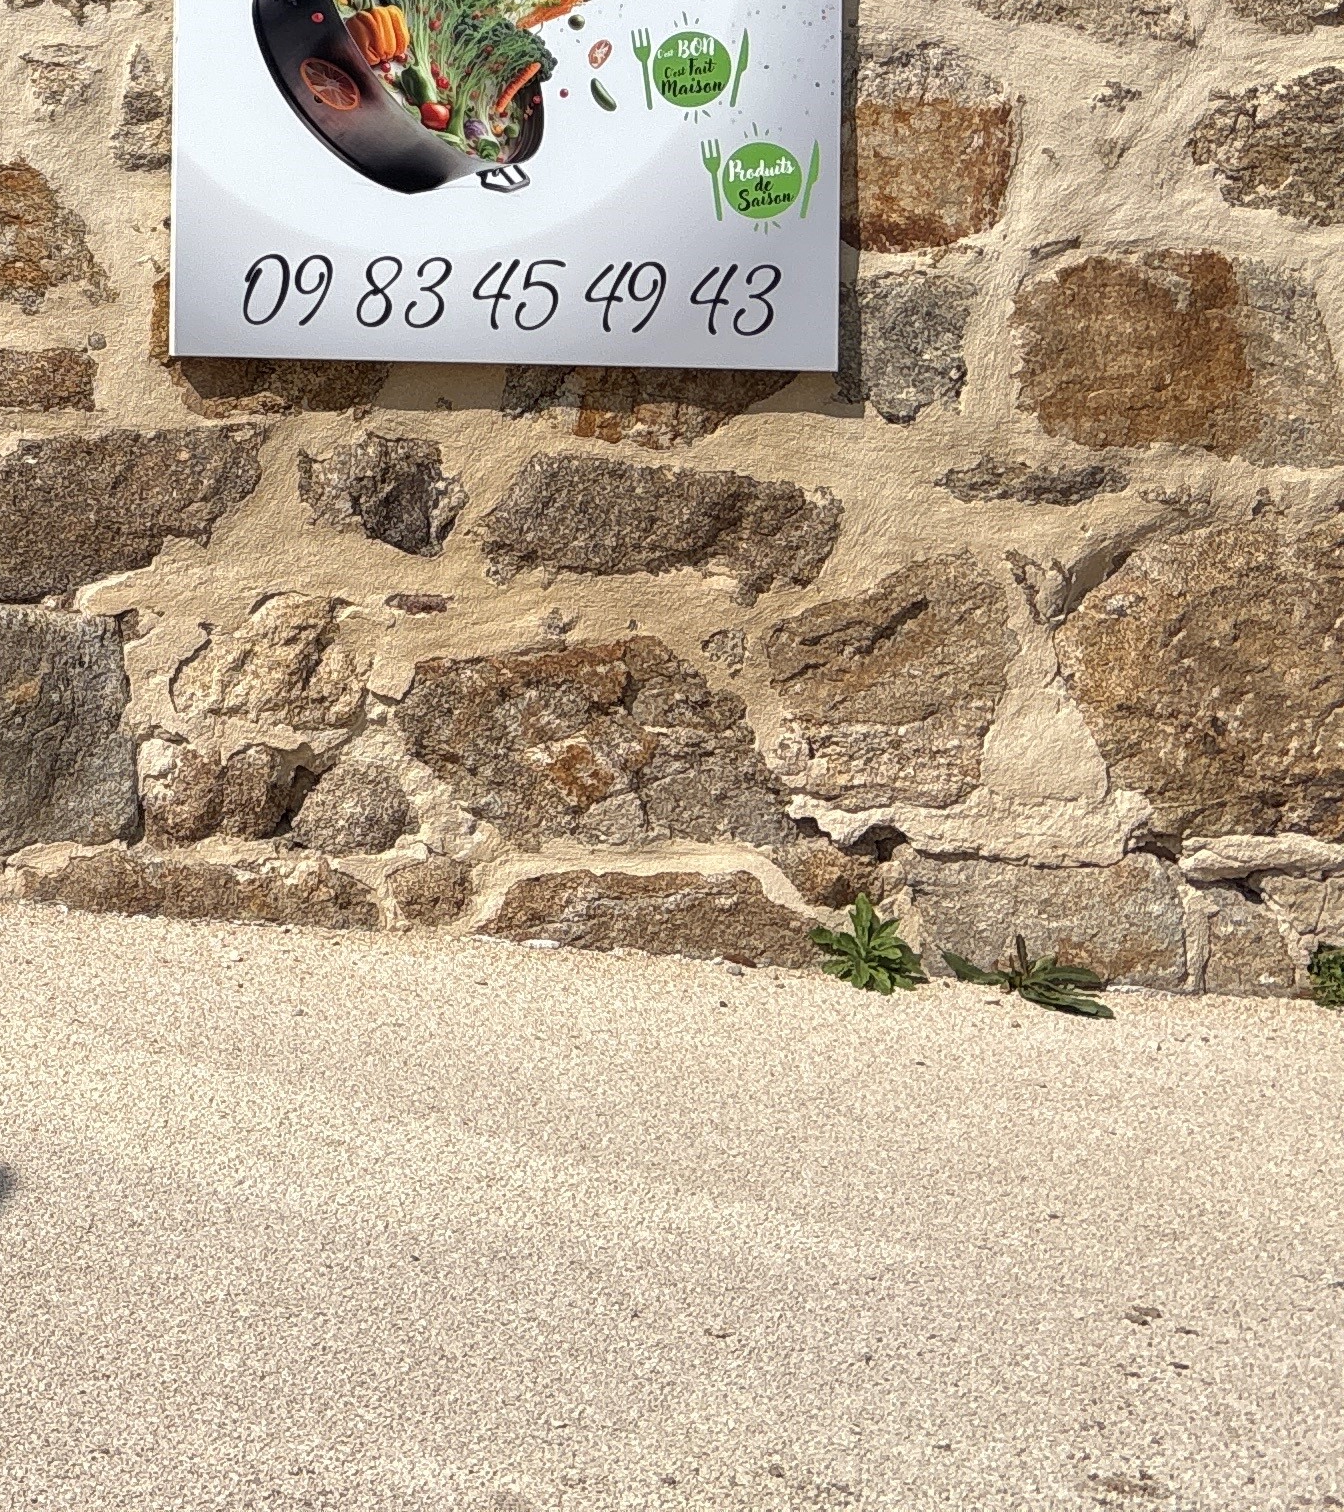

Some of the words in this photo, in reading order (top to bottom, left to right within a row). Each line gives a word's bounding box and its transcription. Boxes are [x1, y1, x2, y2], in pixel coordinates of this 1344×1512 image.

[687, 57, 717, 77] Fait
[661, 77, 726, 98] Maison
[728, 155, 795, 183] Produits
[754, 176, 774, 193] de
[736, 188, 795, 212] Saison
[242, 253, 333, 327] 09
[355, 256, 446, 331] 83
[472, 259, 567, 332] 45
[584, 261, 667, 334] 49
[689, 263, 782, 337] 43
